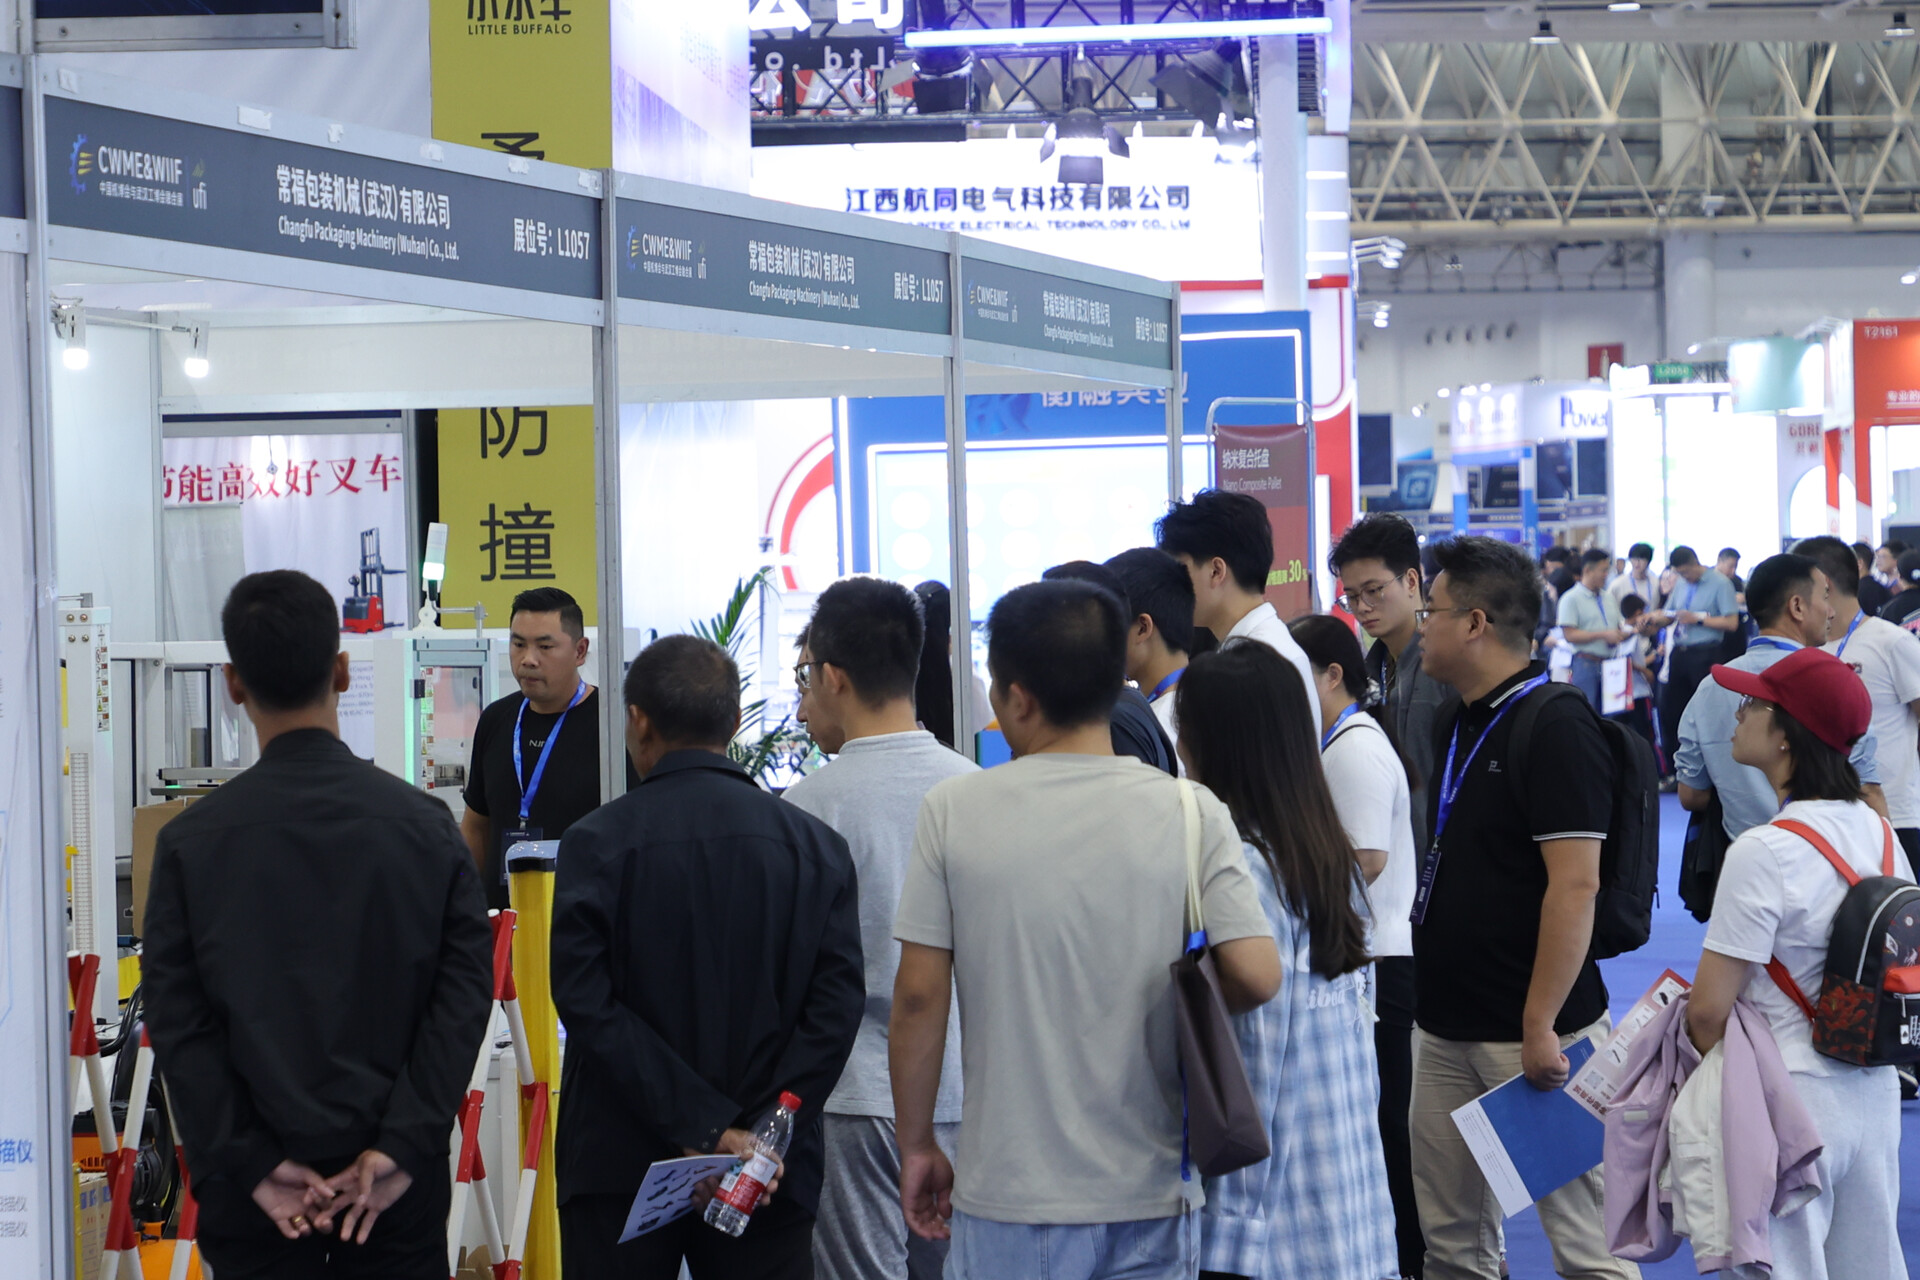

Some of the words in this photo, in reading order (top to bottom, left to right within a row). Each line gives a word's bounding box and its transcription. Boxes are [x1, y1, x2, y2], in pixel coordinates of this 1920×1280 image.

[468, 24, 507, 35] LITTLE
[513, 24, 572, 35] BUFFALO
[98, 145, 182, 184] CWME&WIIF
[846, 186, 1189, 212] 江西航同电气科技有限公司
[278, 215, 314, 243] Changfu
[314, 220, 356, 250] Packaging
[356, 228, 396, 255] Machinery
[397, 233, 429, 259] (Wuhan)
[445, 242, 460, 261] Ltd.
[642, 233, 692, 261] CWME&WIIF
[749, 280, 771, 301] Changfu
[771, 283, 796, 305] Packaging
[796, 287, 821, 308] Machinery
[1222, 449, 1270, 469] 纳米复合托盘
[1238, 478, 1267, 493] Composite
